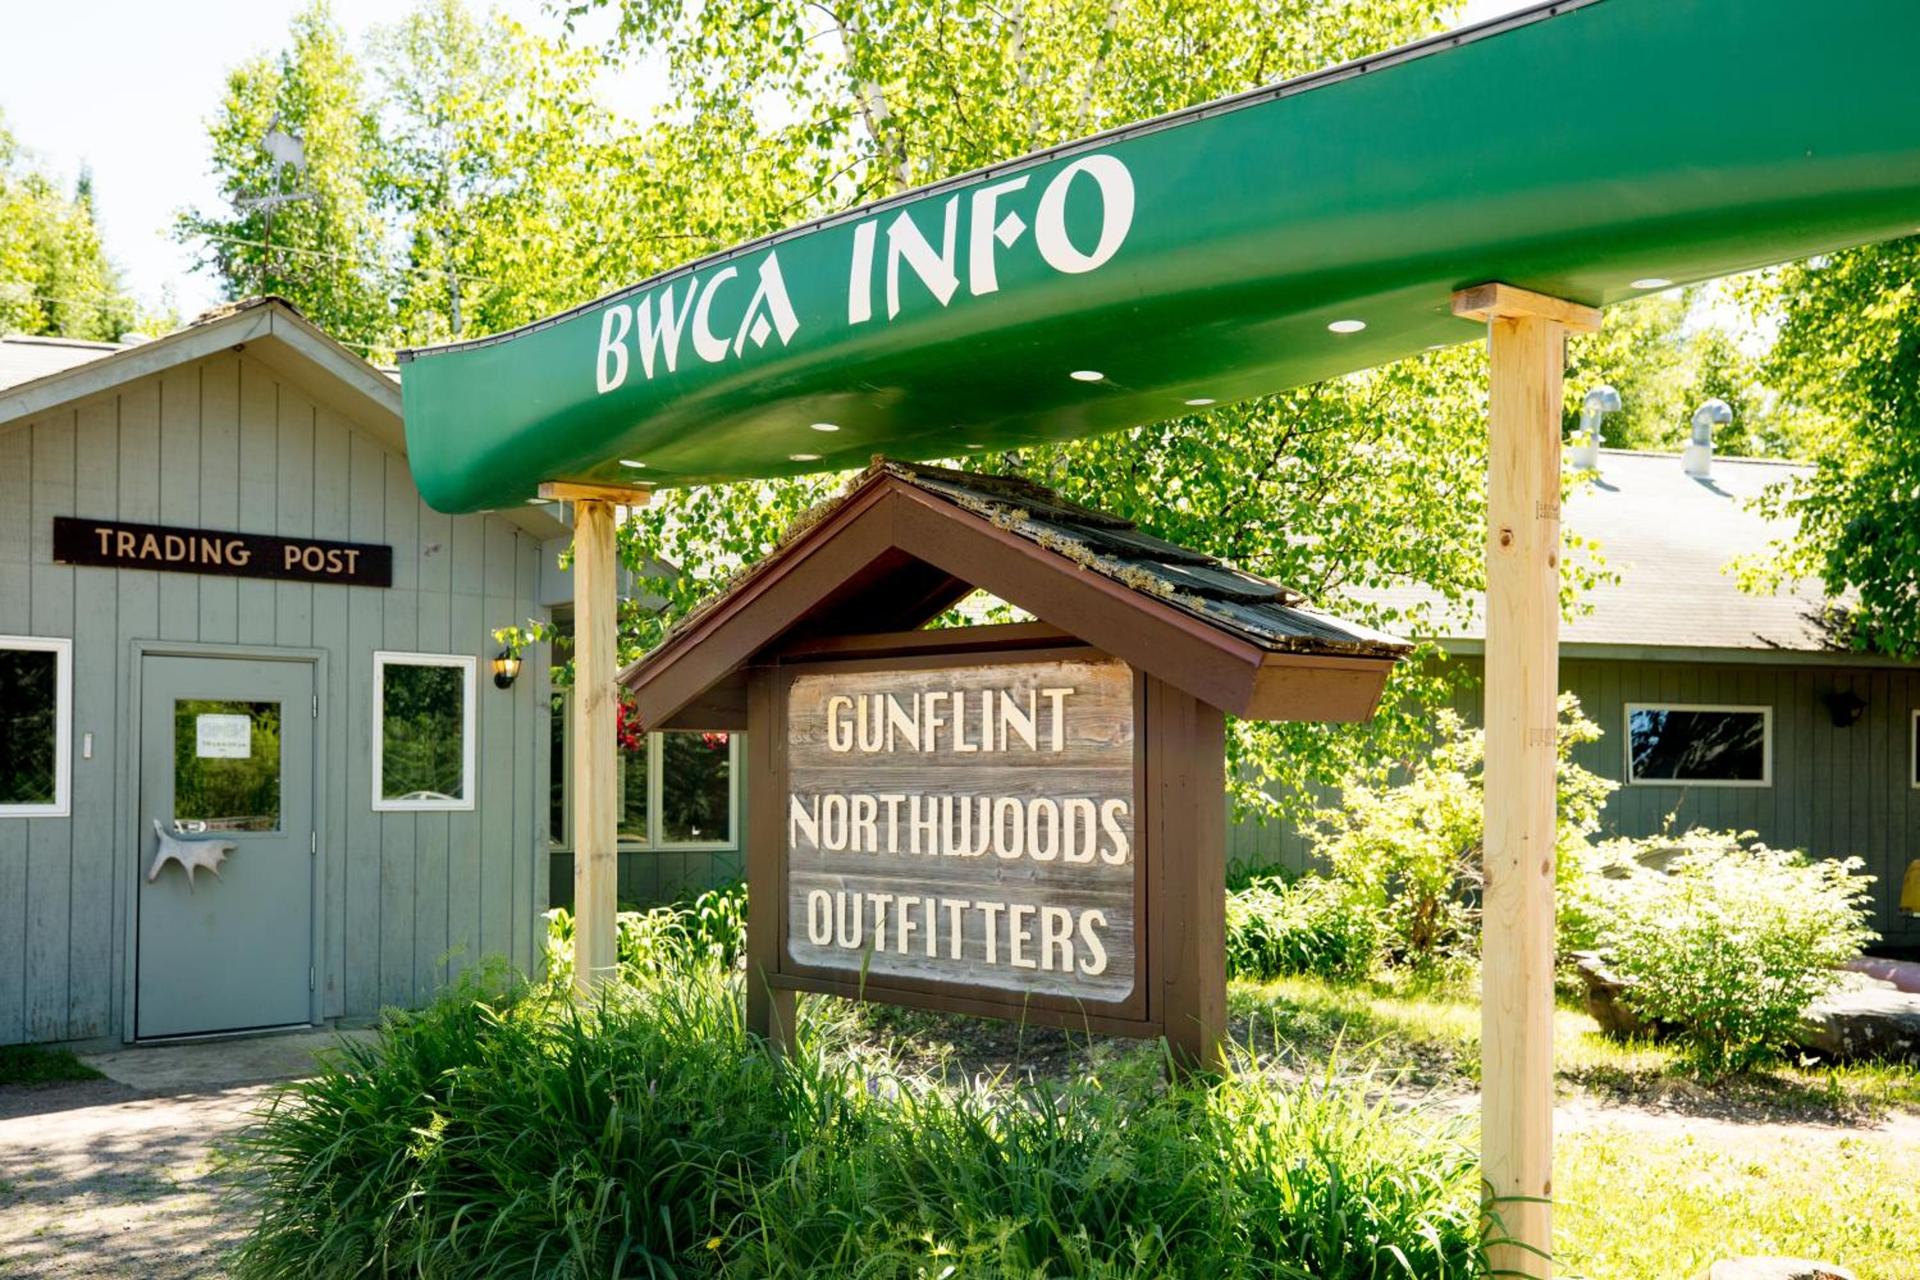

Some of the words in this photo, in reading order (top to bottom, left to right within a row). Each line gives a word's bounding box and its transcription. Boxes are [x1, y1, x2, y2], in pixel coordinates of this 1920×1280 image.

[596, 250, 800, 394] BWCA
[848, 154, 1136, 325] INFO
[95, 528, 252, 567] TRADING
[285, 545, 360, 575] POST
[827, 688, 1075, 753] GUNFLINT
[790, 793, 1130, 866] NORTHWOODS
[807, 889, 1108, 976] OUTFITTERS
